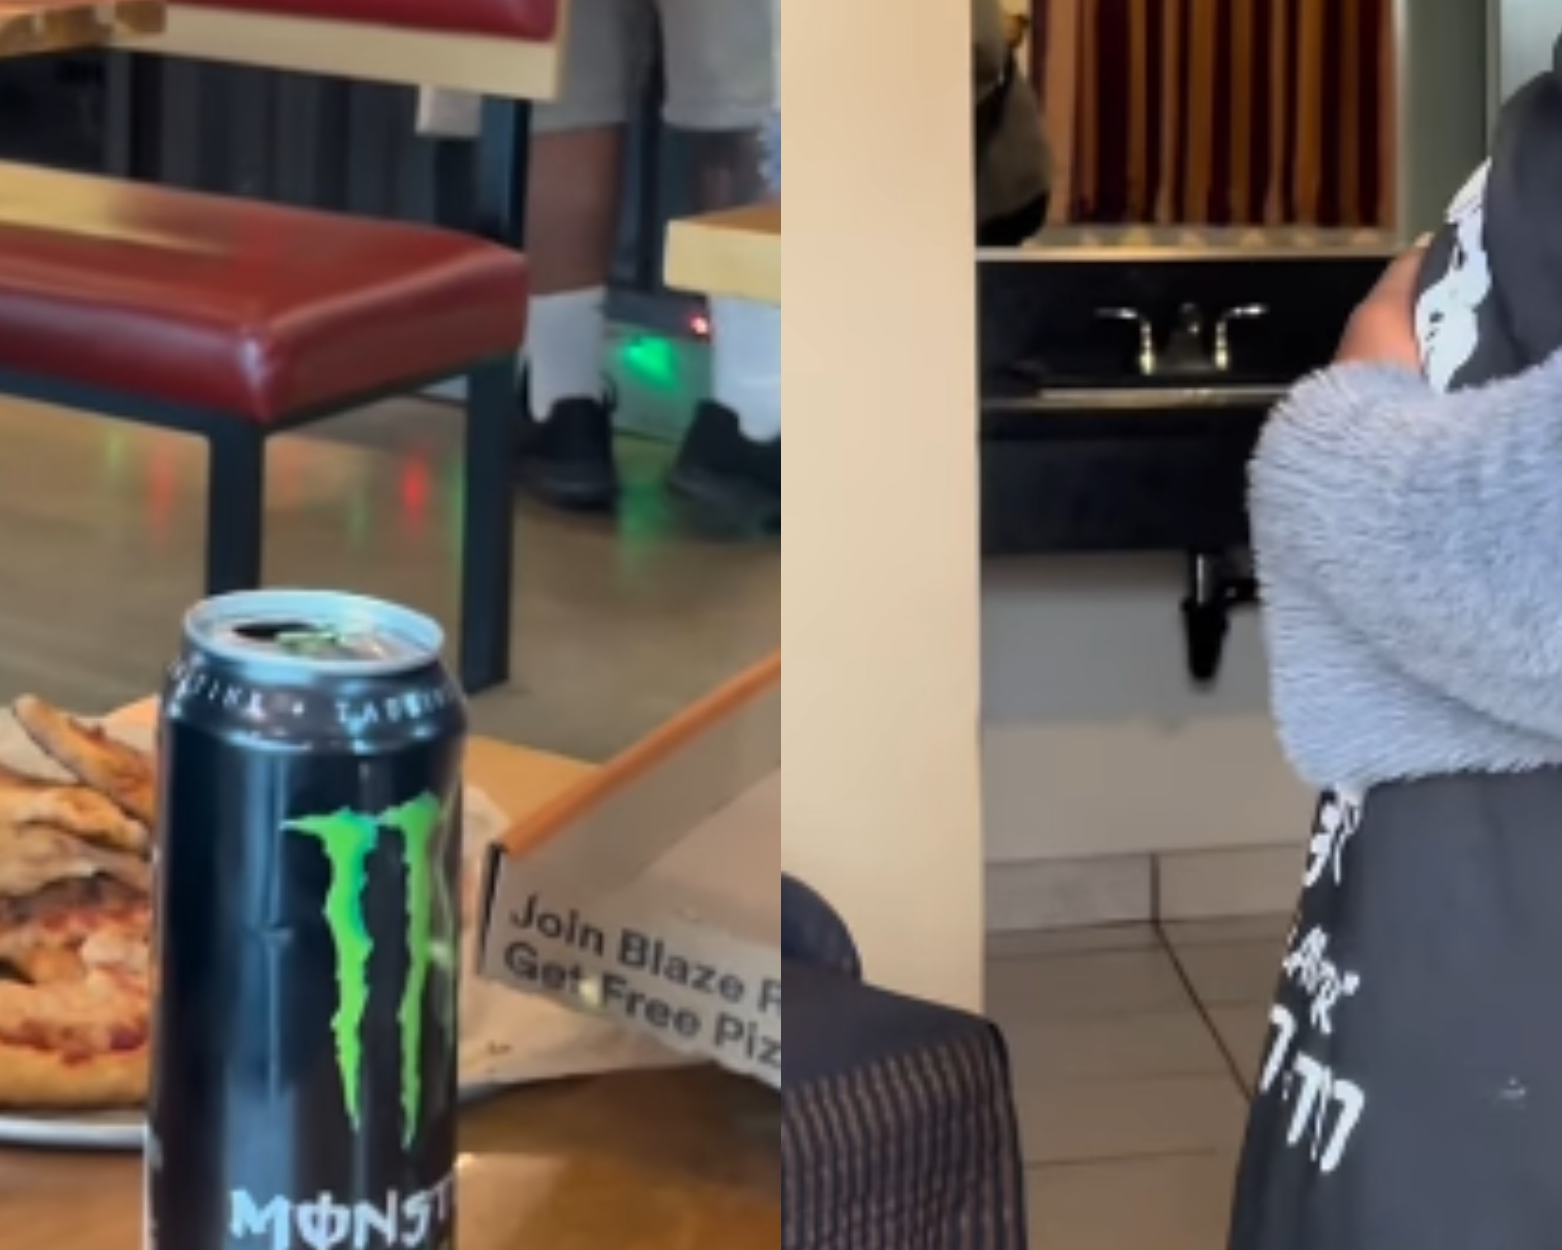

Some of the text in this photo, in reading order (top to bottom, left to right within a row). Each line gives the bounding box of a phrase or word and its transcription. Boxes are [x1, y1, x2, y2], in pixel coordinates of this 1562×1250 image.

[503, 940, 584, 994] Get
[598, 972, 701, 1037] Free
[509, 894, 605, 956] Join
[616, 928, 745, 1004] Blaze
